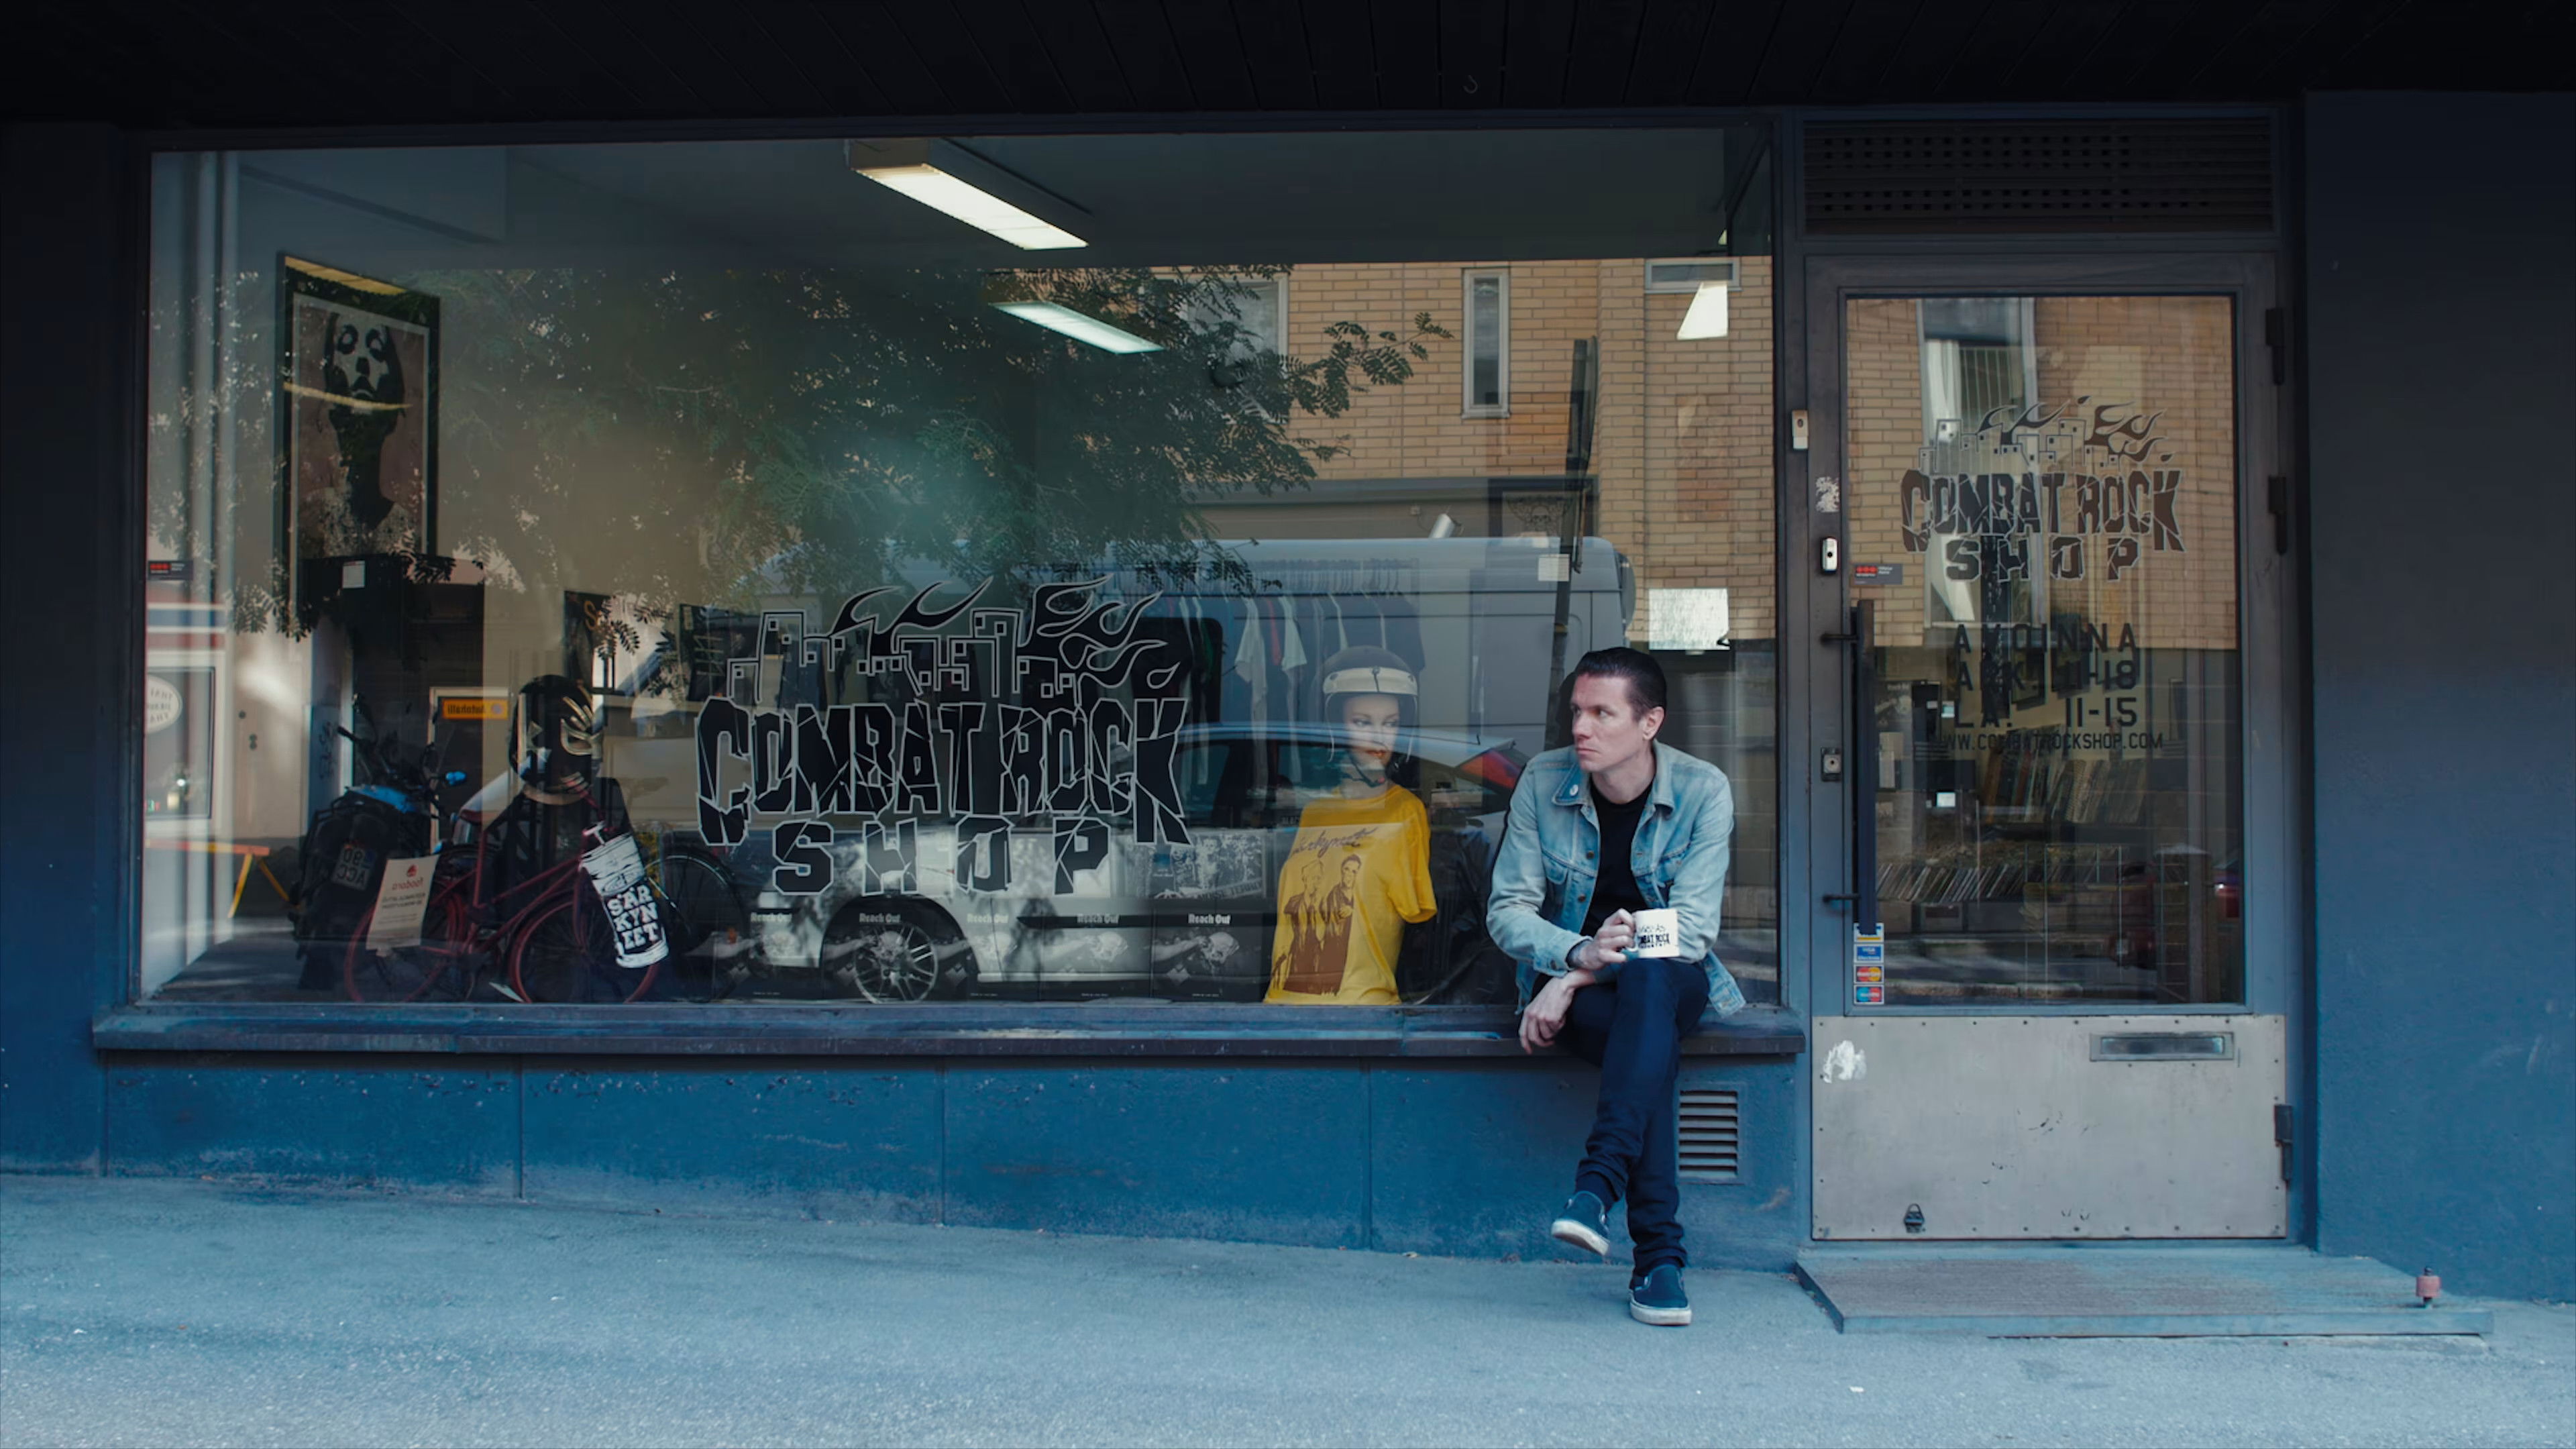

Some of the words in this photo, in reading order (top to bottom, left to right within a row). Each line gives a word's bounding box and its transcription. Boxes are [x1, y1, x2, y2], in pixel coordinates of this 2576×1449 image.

[1900, 469, 2065, 552] COMBAT
[2076, 469, 2185, 552] ROCK
[1946, 537, 2140, 582] SHOP
[2065, 698, 2139, 729] 11-15
[1931, 733, 2163, 751] WW.COMBATROCKSHOP.COM
[694, 696, 986, 846] COMBAT
[998, 697, 1193, 846] ROCK
[772, 814, 1112, 896] SHOP
[606, 884, 654, 917] SÄR
[613, 902, 659, 933] KYN
[859, 912, 883, 923] Reach
[885, 912, 901, 923] Out
[1188, 913, 1214, 924] Reach
[1215, 913, 1231, 924] Out
[621, 921, 660, 951] EET
